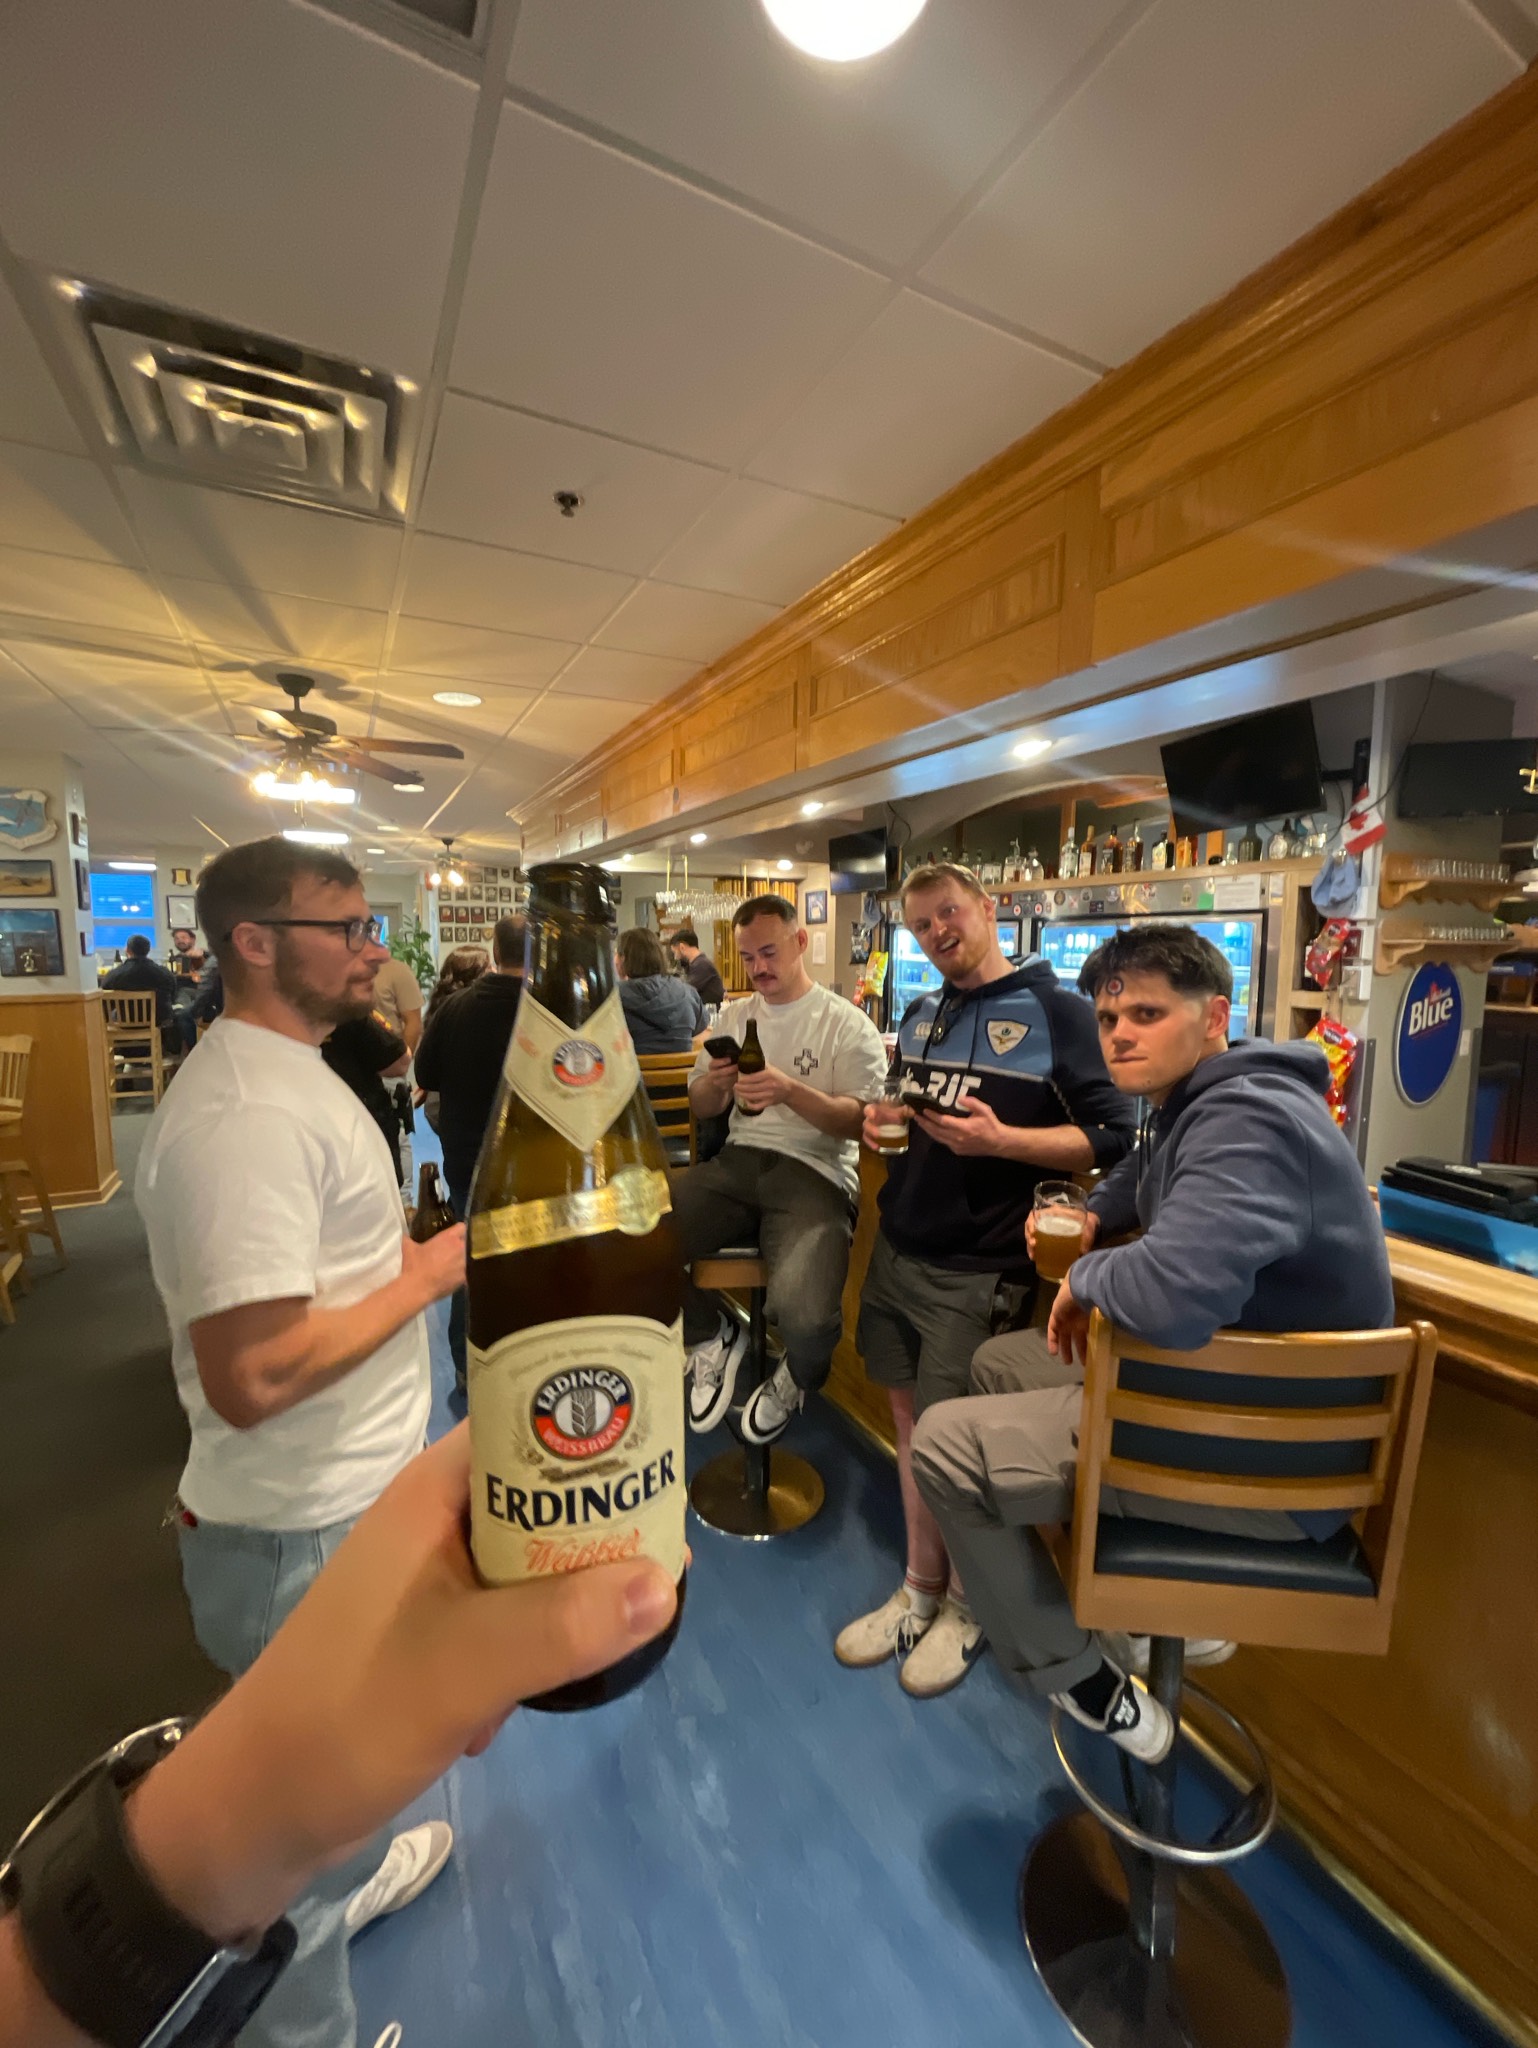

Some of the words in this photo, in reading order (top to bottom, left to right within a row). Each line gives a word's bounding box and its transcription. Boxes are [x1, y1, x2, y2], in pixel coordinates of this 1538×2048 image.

[1408, 996, 1454, 1036] Blue
[537, 1368, 627, 1411] ERDINGER
[486, 1449, 676, 1531] ERDINGER
